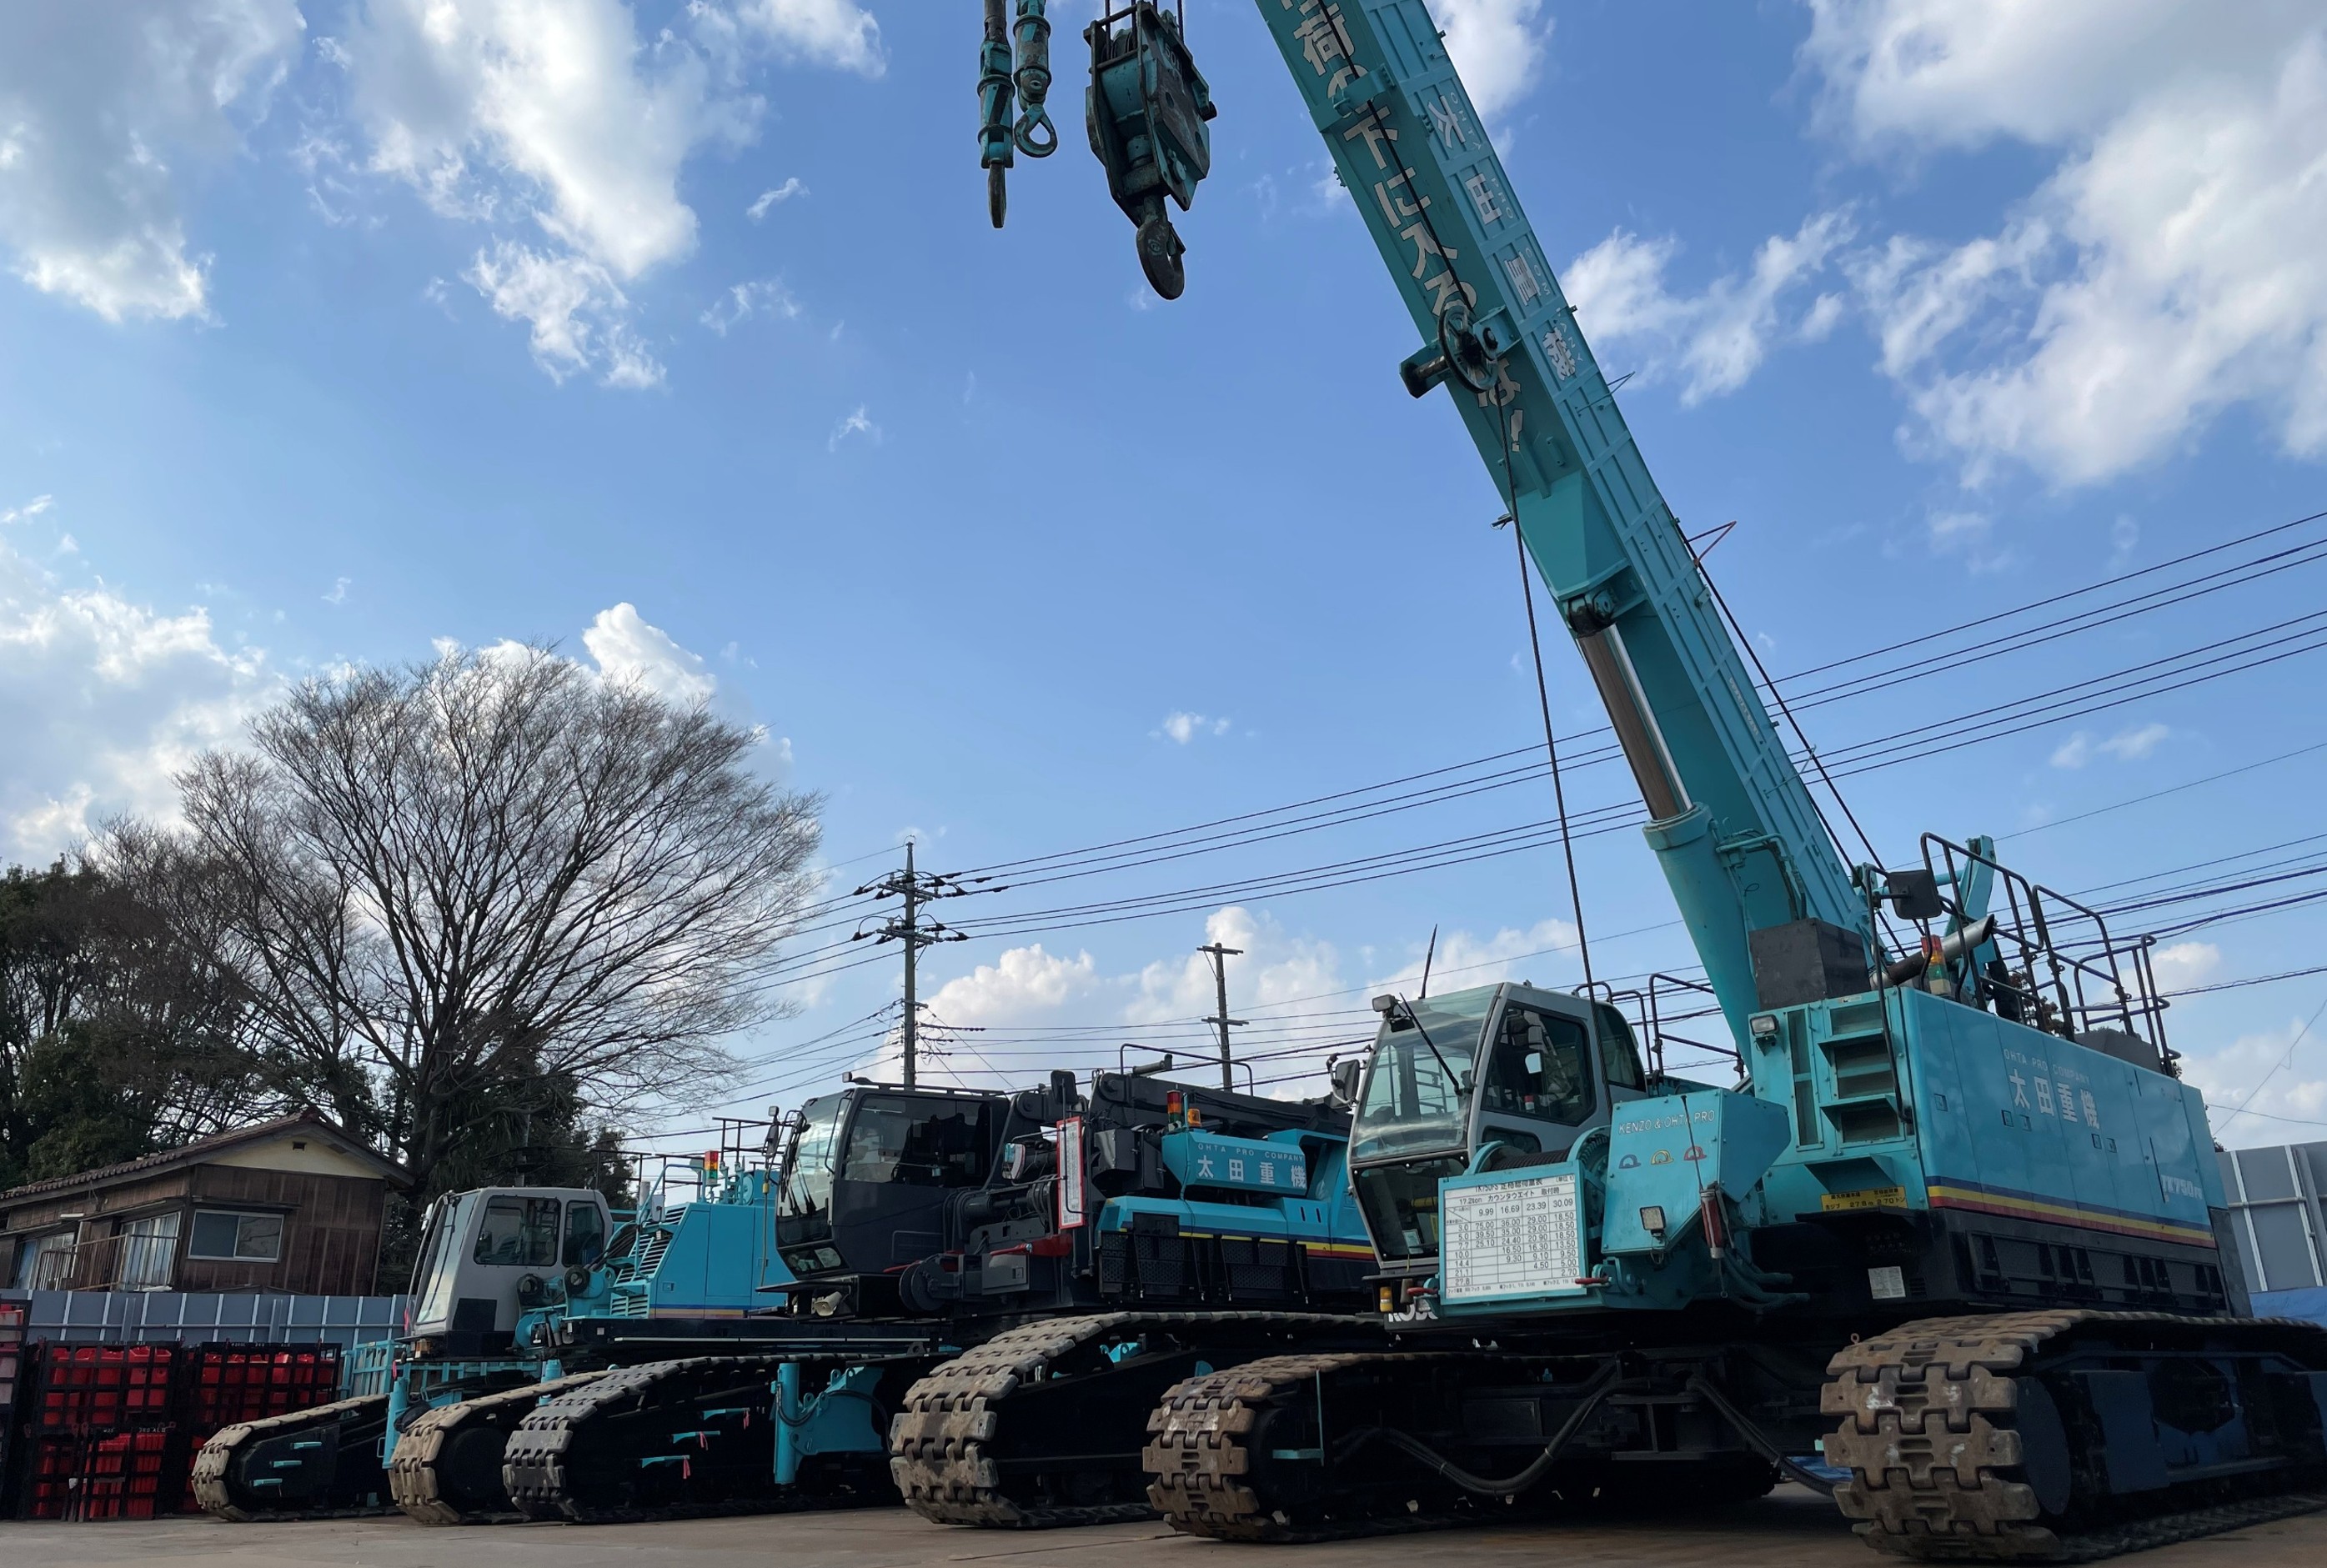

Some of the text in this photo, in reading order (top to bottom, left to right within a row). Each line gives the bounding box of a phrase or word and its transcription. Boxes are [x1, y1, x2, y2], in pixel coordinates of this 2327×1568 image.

[1427, 95, 1576, 381] 太田重機
[2004, 1049, 2028, 1065] OHTA
[2031, 1057, 2049, 1071] PRO
[2009, 1068, 2100, 1130] 太田重機
[1619, 1120, 1652, 1134] KENZO
[1654, 1118, 1661, 1129] &
[1694, 1110, 1715, 1123] PRO
[1198, 1143, 1303, 1161] OHTA PRO COMPANY
[1197, 1155, 1306, 1188] 太田重機
